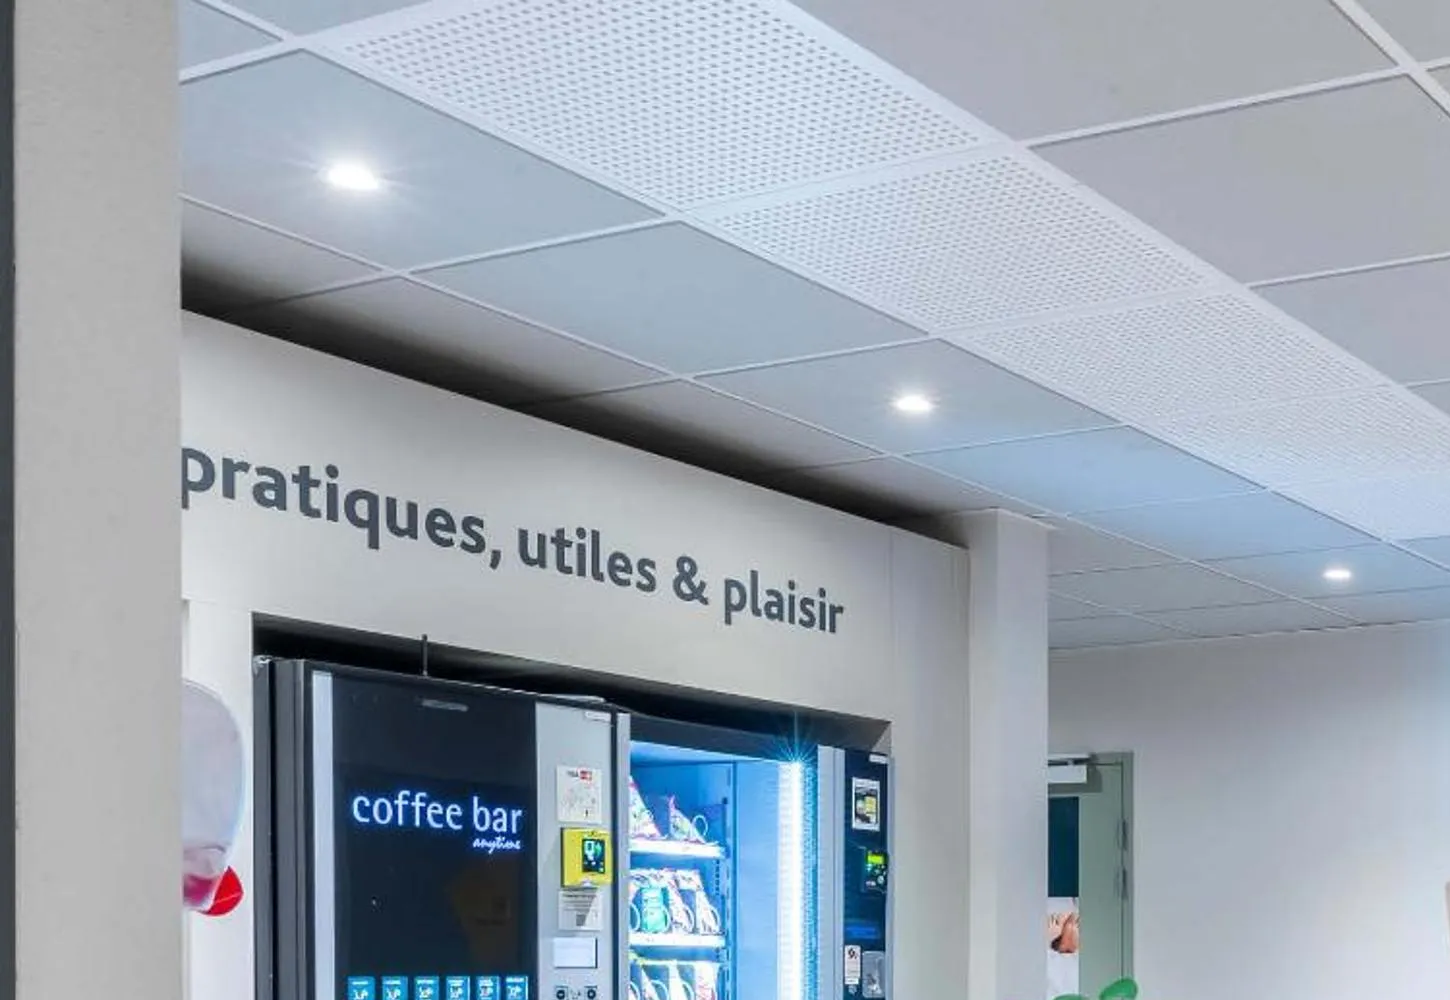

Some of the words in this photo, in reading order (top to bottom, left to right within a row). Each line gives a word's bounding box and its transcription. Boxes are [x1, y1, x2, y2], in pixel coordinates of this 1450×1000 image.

[182, 447, 501, 570] pratiques,
[518, 527, 656, 593] utiles
[672, 554, 709, 605] &
[724, 569, 844, 633] plaisir
[353, 790, 463, 830] coffee
[473, 795, 522, 834] bar
